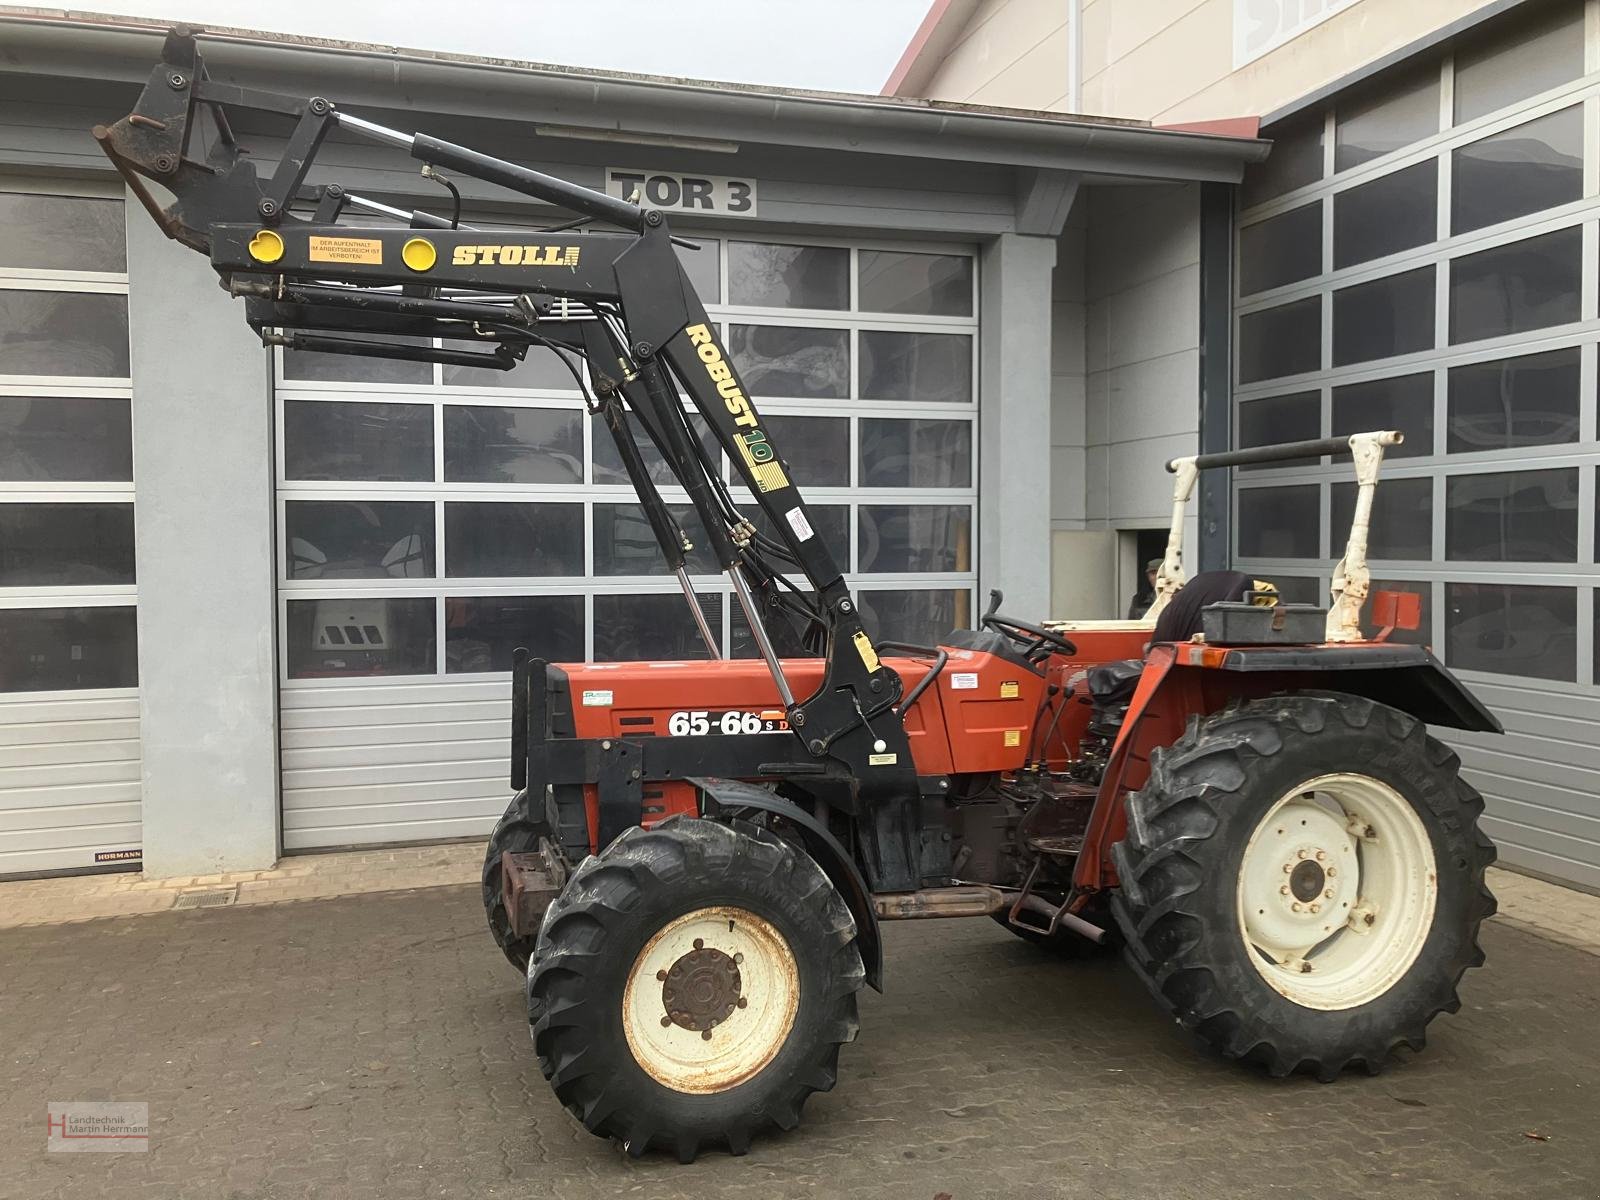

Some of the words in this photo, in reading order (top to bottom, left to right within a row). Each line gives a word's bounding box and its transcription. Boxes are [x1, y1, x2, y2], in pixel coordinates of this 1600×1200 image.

[611, 171, 715, 210] TOR
[727, 181, 752, 212] 3
[452, 245, 564, 266] STOLL
[685, 323, 759, 428] ROBUST
[743, 429, 774, 463] 10
[668, 710, 761, 736] 65-66
[766, 721, 773, 731] S
